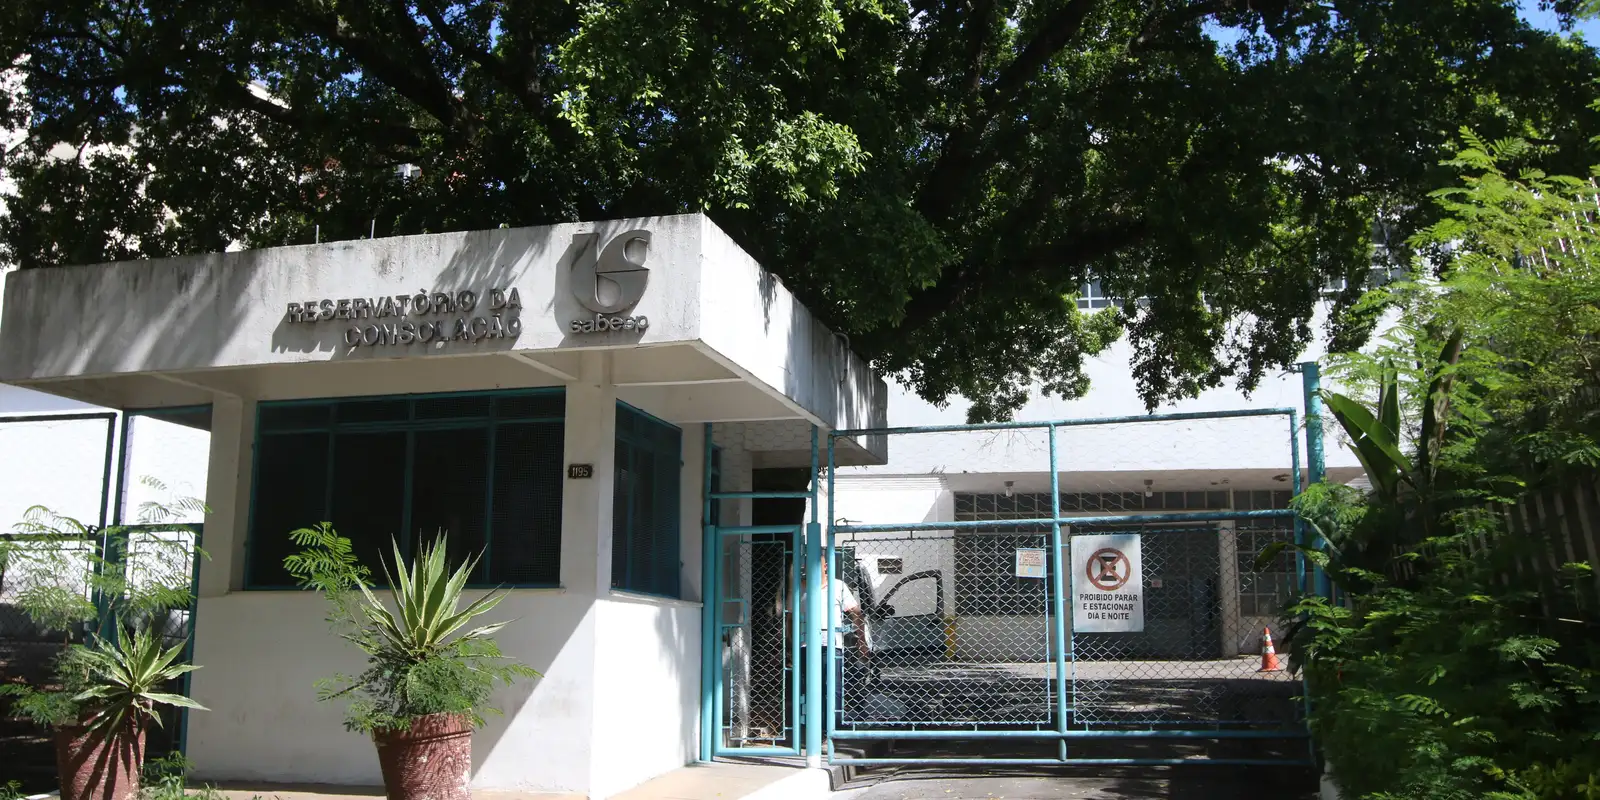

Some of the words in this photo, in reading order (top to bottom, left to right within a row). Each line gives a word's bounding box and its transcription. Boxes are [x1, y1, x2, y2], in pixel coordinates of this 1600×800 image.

[286, 287, 477, 324] RESERVATÓRIO
[491, 287, 523, 310] DA
[569, 313, 649, 335] sabesp
[344, 314, 522, 347] CONSOLAÇÃO
[572, 467, 589, 477] 1195
[1080, 593, 1113, 601] PROIBIDO
[1114, 593, 1138, 601] PARAR
[1089, 603, 1134, 611] ESTACIONAR
[1087, 612, 1100, 620] DIA
[1101, 612, 1106, 620] E
[1107, 612, 1130, 620] NOITE
